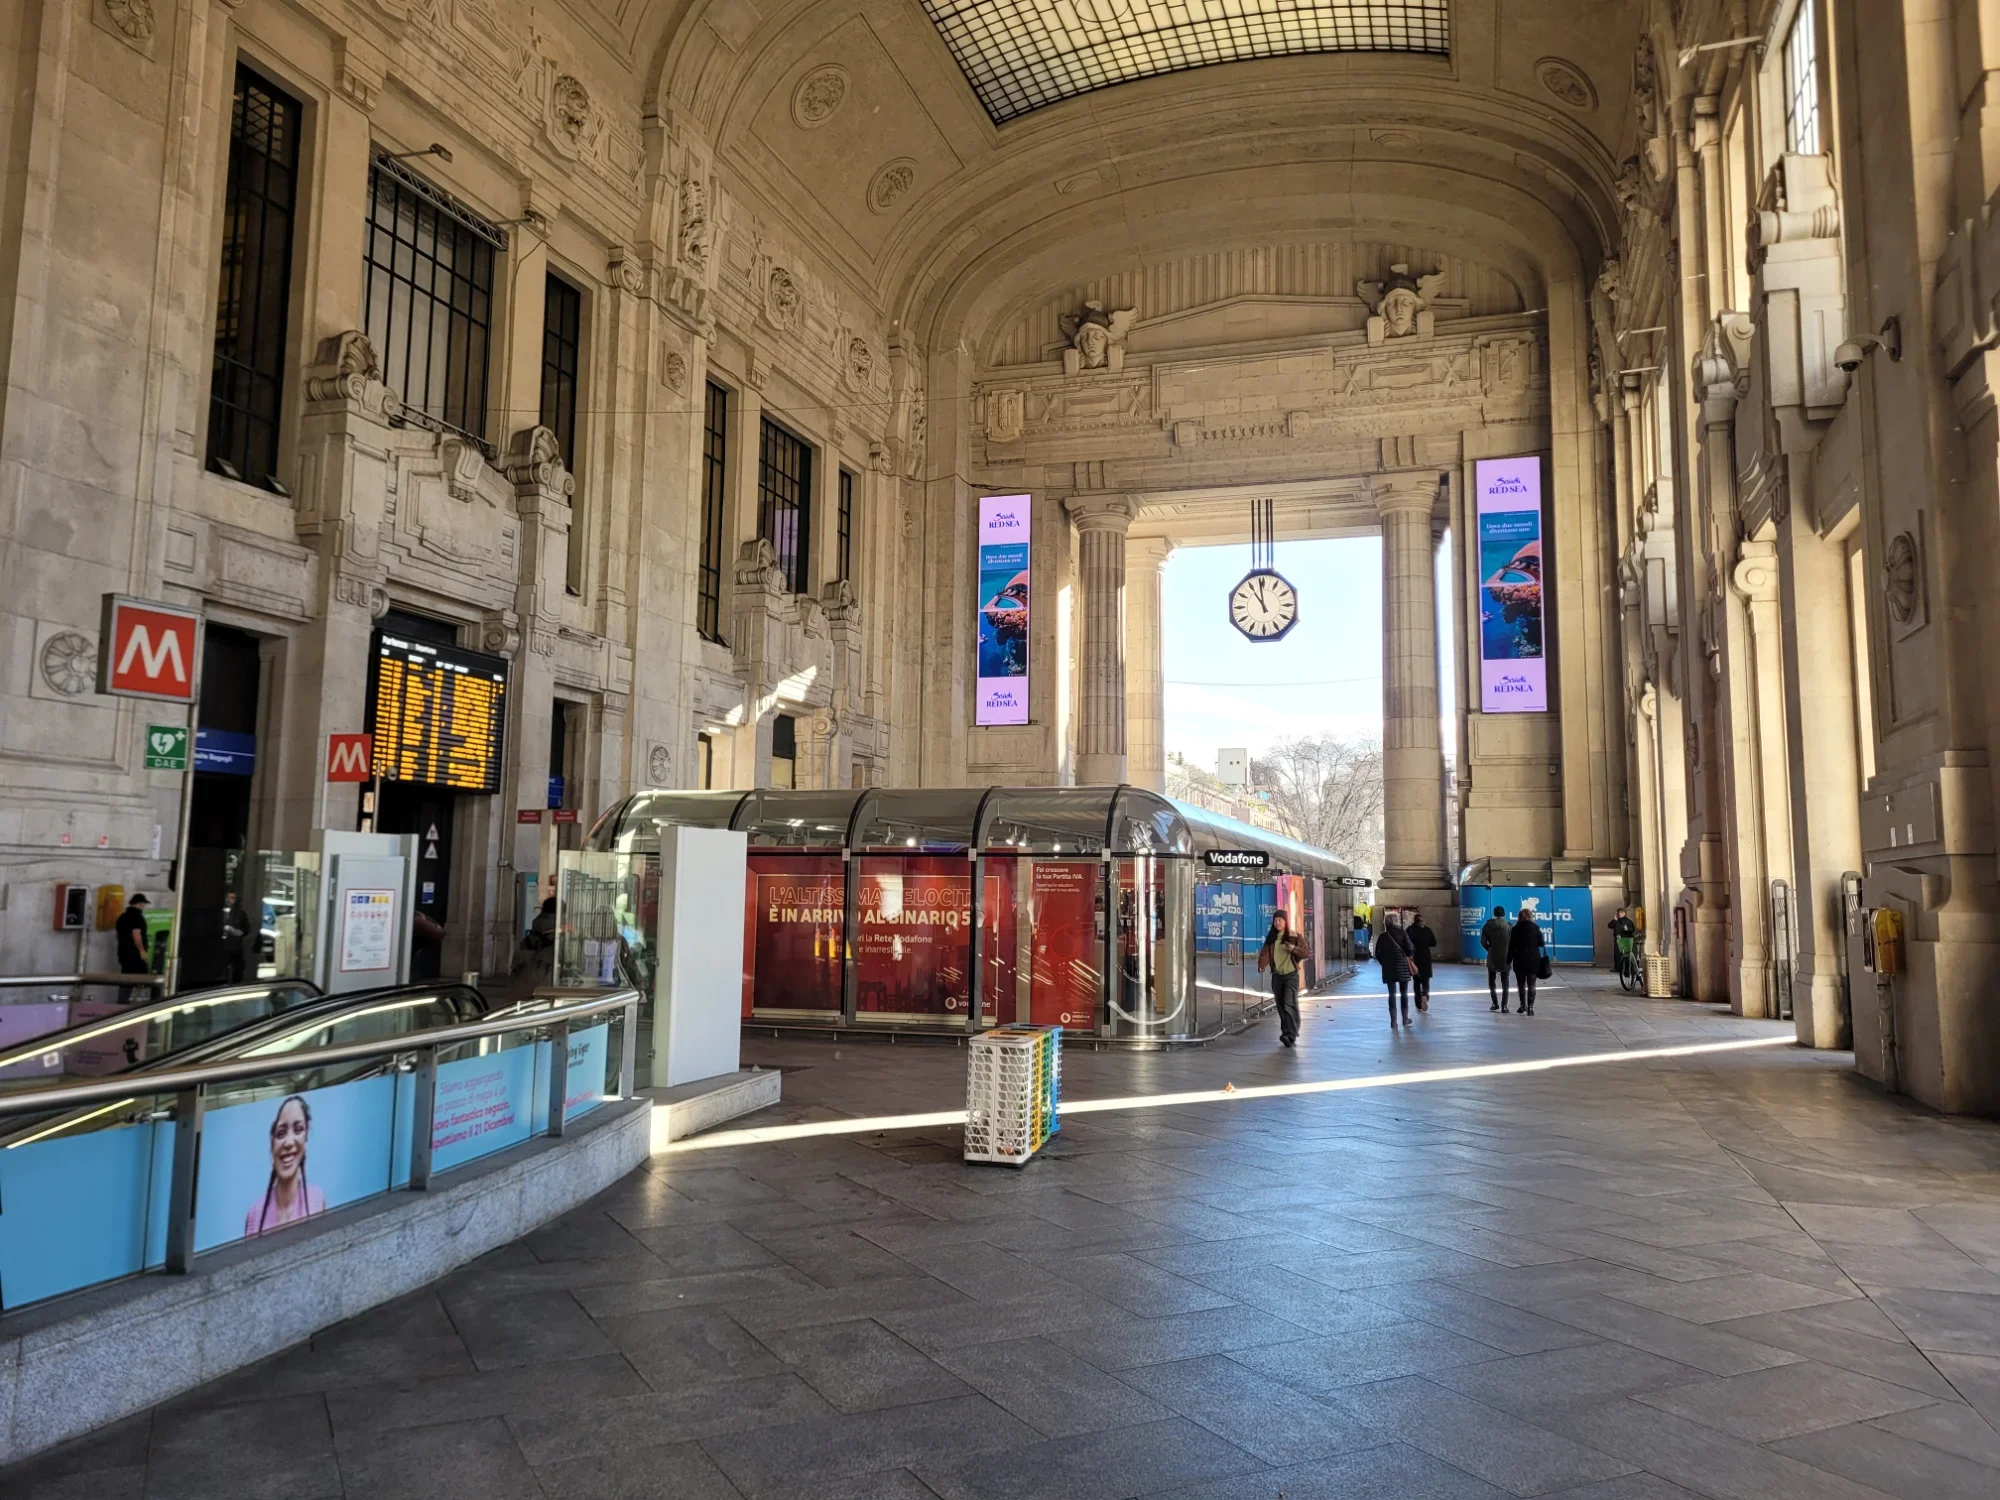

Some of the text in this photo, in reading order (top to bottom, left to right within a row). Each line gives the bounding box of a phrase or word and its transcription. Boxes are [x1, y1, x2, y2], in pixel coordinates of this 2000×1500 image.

[1494, 476, 1520, 486] Saudi
[1489, 485, 1527, 494] RED SEA
[993, 512, 1015, 521] Saudi
[117, 624, 187, 683] M
[1500, 675, 1526, 685] Saudi
[1494, 684, 1533, 693] RED SEA
[991, 691, 1012, 700] Saudi
[986, 700, 1002, 708] RED
[330, 742, 368, 773] M
[155, 759, 177, 768] DAE
[1210, 852, 1264, 865] Vodafone
[769, 886, 971, 907] L'ALTISSMA ELOCIT
[769, 904, 779, 923] È
[782, 908, 797, 923] IN
[864, 910, 882, 924] AL
[961, 912, 971, 926] 5
[866, 934, 872, 942] la
[894, 935, 933, 943] odafone
[865, 944, 913, 953] inarrestile.
[440, 1070, 504, 1095] Siamo aggiungendo
[451, 1107, 483, 1126] fantastico
[475, 1124, 482, 1136] 21
[484, 1112, 515, 1133] Dicembre!
